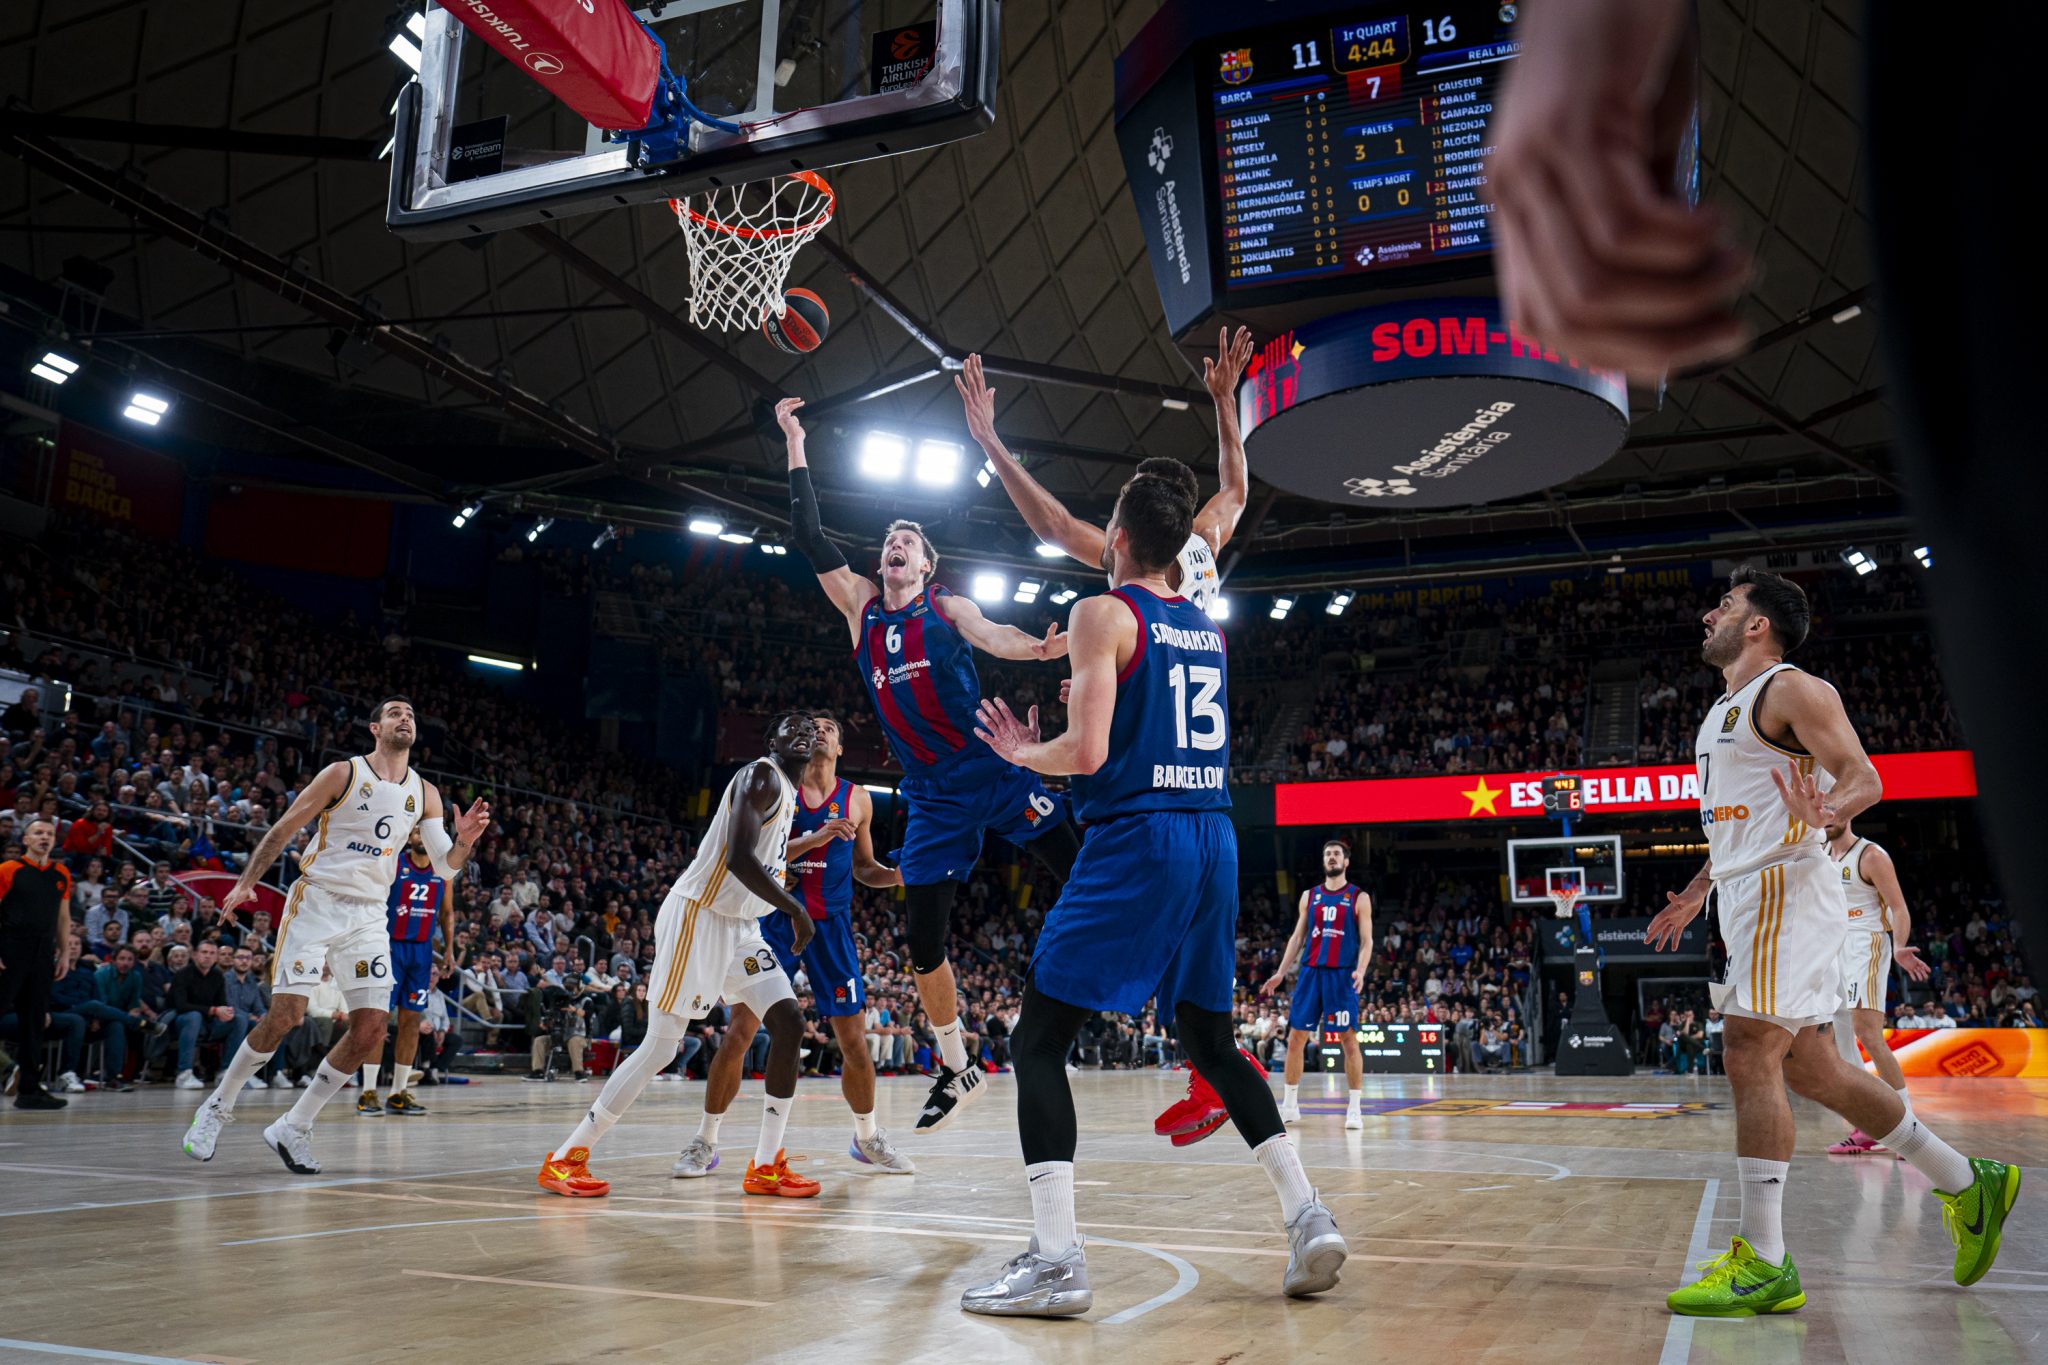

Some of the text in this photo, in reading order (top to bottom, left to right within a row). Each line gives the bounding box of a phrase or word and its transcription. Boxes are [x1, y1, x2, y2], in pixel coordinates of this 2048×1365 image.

[1356, 21, 1398, 40] QUART
[1422, 15, 1456, 45] 16
[1292, 40, 1321, 70] 11
[1348, 38, 1396, 62] 4:44
[1468, 42, 1526, 60] REAL MAD
[882, 58, 929, 75] TURKISH
[1366, 76, 1381, 99] 7
[1438, 76, 1482, 91] CAUSEUR
[1220, 91, 1252, 104] BARÇA
[1440, 92, 1477, 105] ABALDE
[1440, 104, 1492, 119] CAMPAZZO
[1231, 118, 1244, 128] DA
[1245, 114, 1270, 126] SILVA
[1432, 119, 1486, 135] 11 HEZONJA
[1232, 127, 1258, 141] PAULÍ
[1361, 123, 1394, 136] FALTES
[1232, 142, 1265, 155] VESELY
[1355, 138, 1404, 160] 3 1
[1432, 134, 1480, 149] 12 ALOCÉN
[1234, 153, 1278, 168] BRIZUELA
[1224, 174, 1234, 184] 10
[1235, 168, 1271, 182] KALINIC
[1435, 162, 1484, 178] 17 POIRIER
[1236, 179, 1294, 196] SATORANSKY
[1352, 173, 1411, 190] TEMPS MORT
[1434, 176, 1488, 192] 22 TAVARES
[1237, 190, 1306, 209] HERNANGÓMEZ
[1358, 189, 1409, 212] 0 0
[1448, 192, 1476, 204] LLULL
[1238, 204, 1303, 222] LAPROVITTOLA
[1448, 204, 1496, 218] YABUSELE
[1156, 186, 1175, 261] Sanitària
[1228, 228, 1238, 238] 22
[1239, 223, 1274, 235] PARKER
[1450, 219, 1485, 232] NDIAYE
[1165, 180, 1191, 285] Assistència
[1451, 234, 1480, 247] MUSA
[1240, 237, 1268, 249] NNAJI
[1241, 247, 1294, 263] JOKUBAITIS
[1242, 264, 1272, 276] PARRA
[1392, 401, 1516, 475] Assistència
[1420, 431, 1511, 478] Sanitària
[886, 625, 901, 654] 6
[888, 658, 931, 675] Assistència
[888, 670, 920, 684] Sanitària
[1169, 663, 1226, 751] 13
[1699, 753, 1710, 795] 7
[1028, 792, 1054, 816] 6
[1570, 792, 1580, 808] 6
[374, 815, 394, 840] 6
[409, 883, 430, 901] 22
[1322, 906, 1337, 922] 10
[1597, 929, 1646, 941] sistència
[370, 954, 387, 978] 6
[417, 989, 430, 1005] 2
[846, 978, 857, 1004] 1
[1335, 1010, 1350, 1026] 10
[1326, 1032, 1340, 1042] 11
[1421, 1032, 1437, 1042] 16
